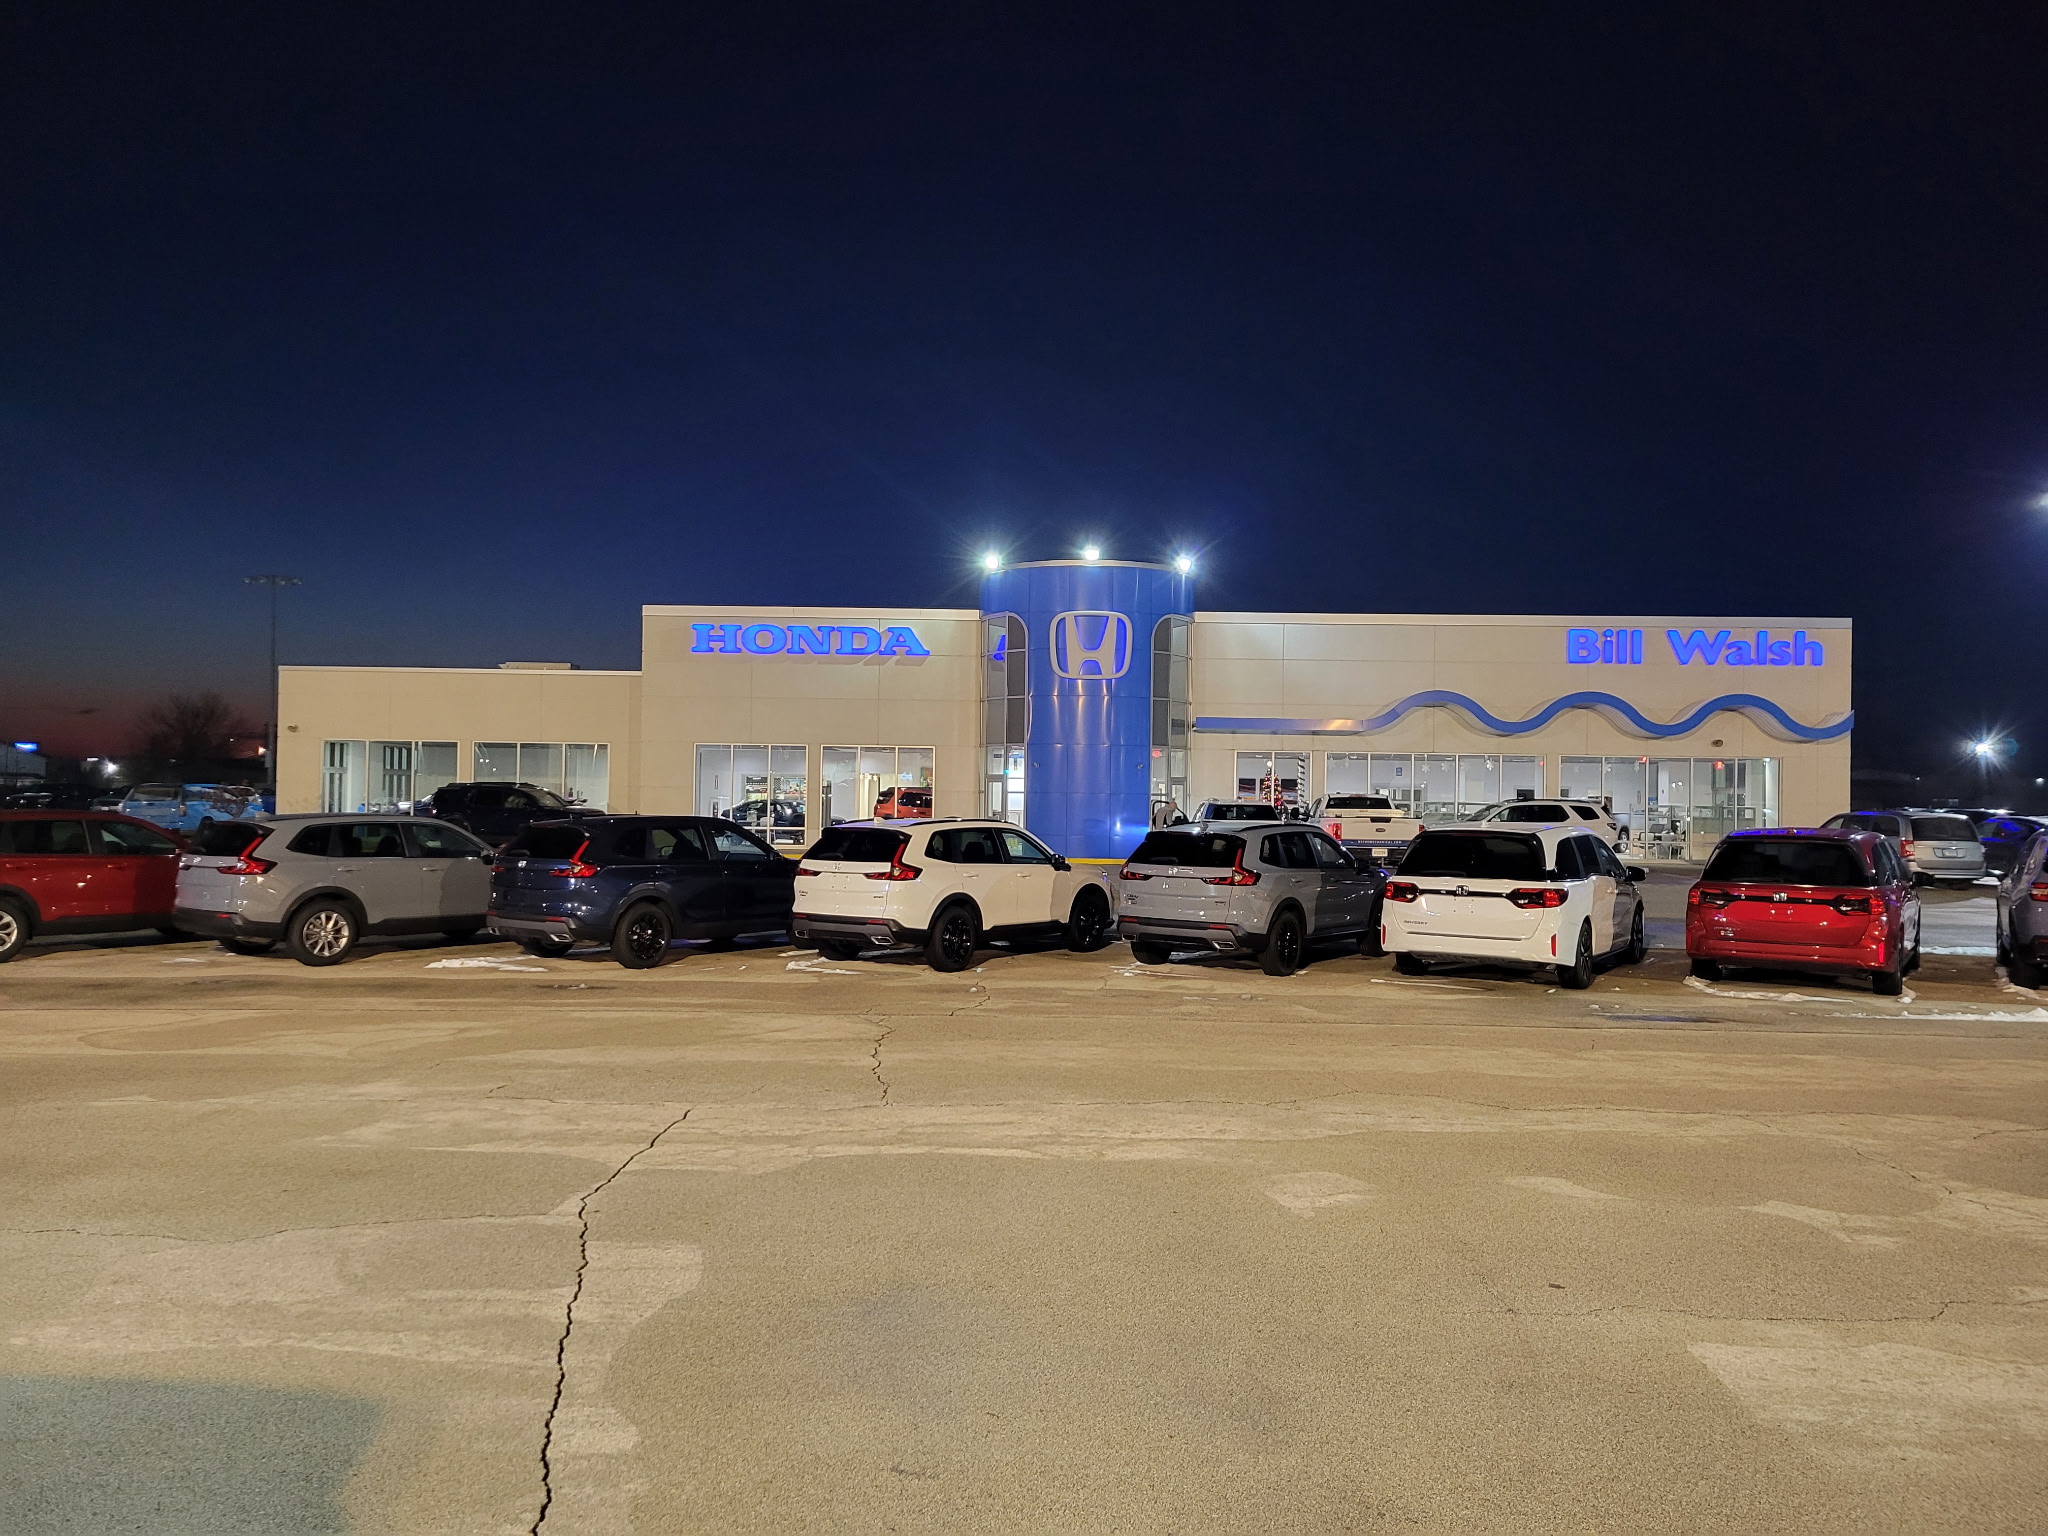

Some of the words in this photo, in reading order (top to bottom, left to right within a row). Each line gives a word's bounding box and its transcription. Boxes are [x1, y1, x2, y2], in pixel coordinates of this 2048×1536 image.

[691, 623, 931, 656] HONDA
[1567, 628, 1643, 664] Bill
[1666, 629, 1824, 666] Walsh
